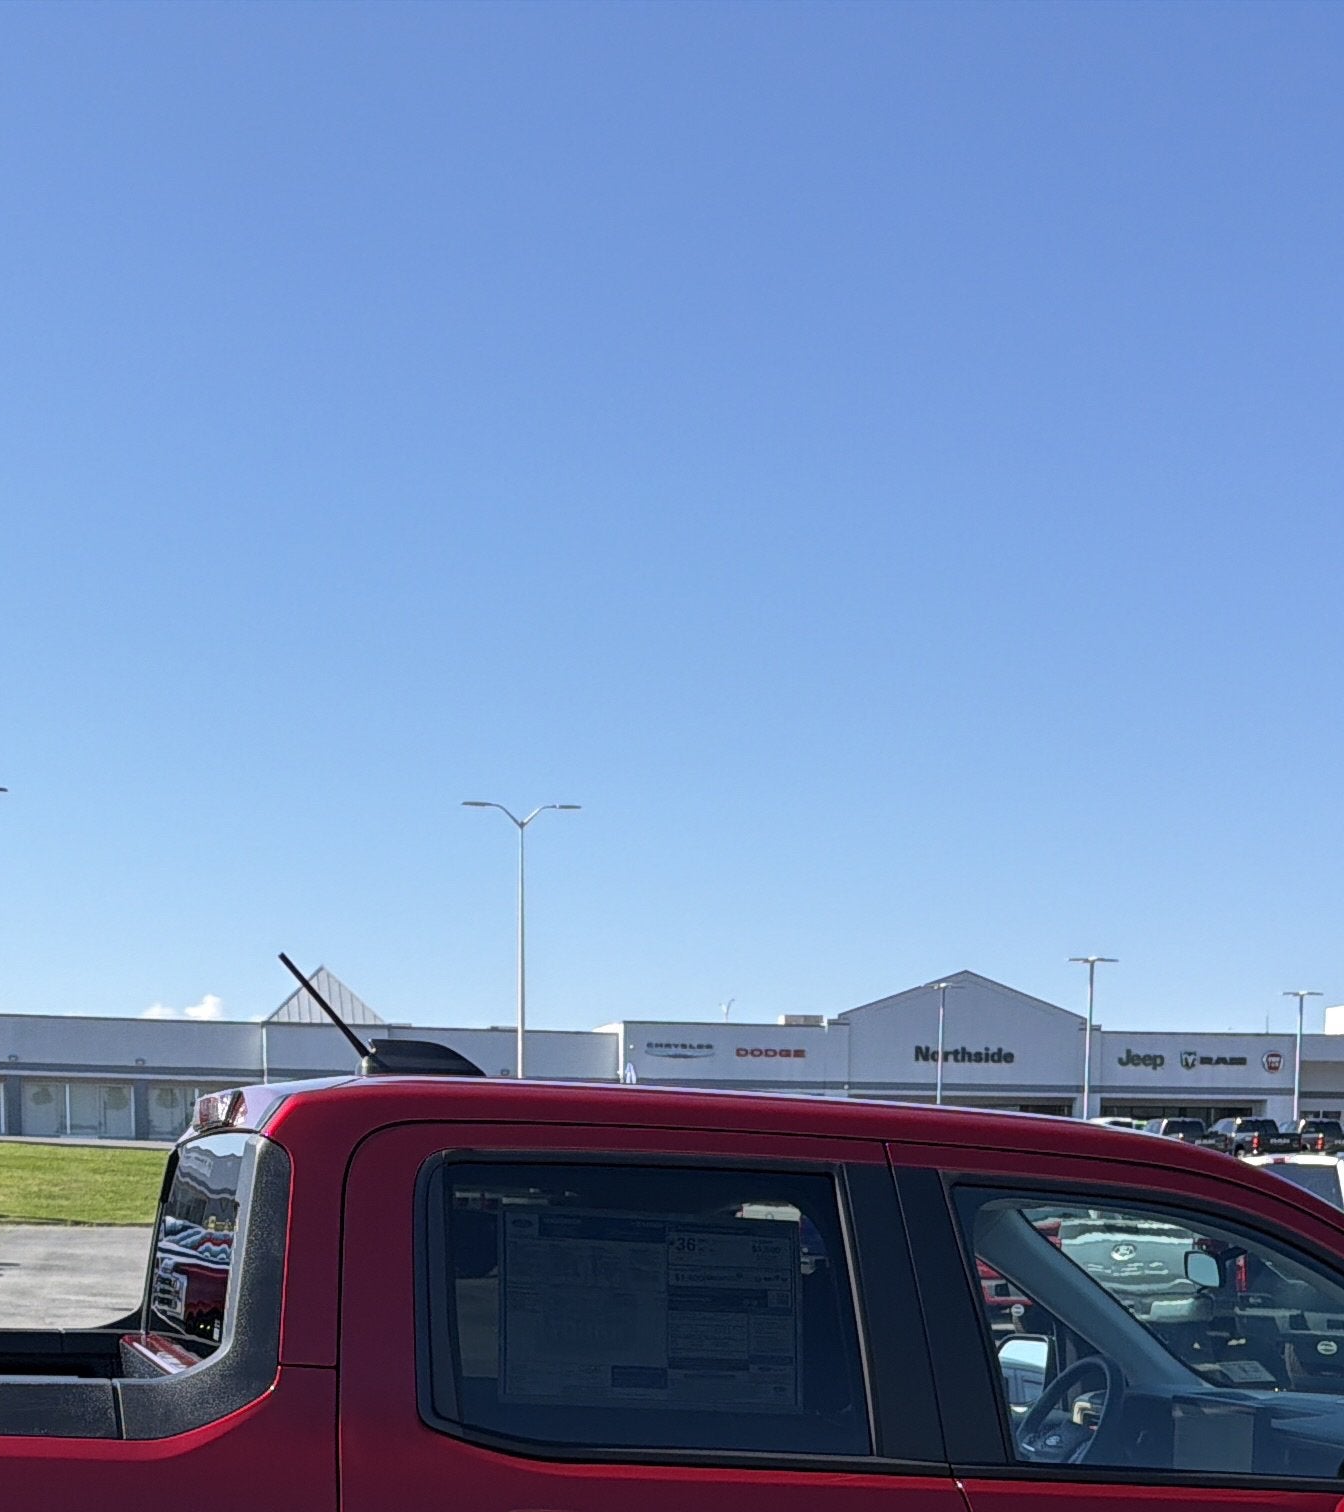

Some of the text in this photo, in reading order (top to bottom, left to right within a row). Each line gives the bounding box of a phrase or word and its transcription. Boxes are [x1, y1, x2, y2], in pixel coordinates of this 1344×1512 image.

[736, 1048, 805, 1058] DODGE
[914, 1045, 1015, 1064] Northside
[1118, 1049, 1164, 1070] Jeep
[1199, 1056, 1247, 1065] RAM
[676, 1237, 697, 1252] 36
